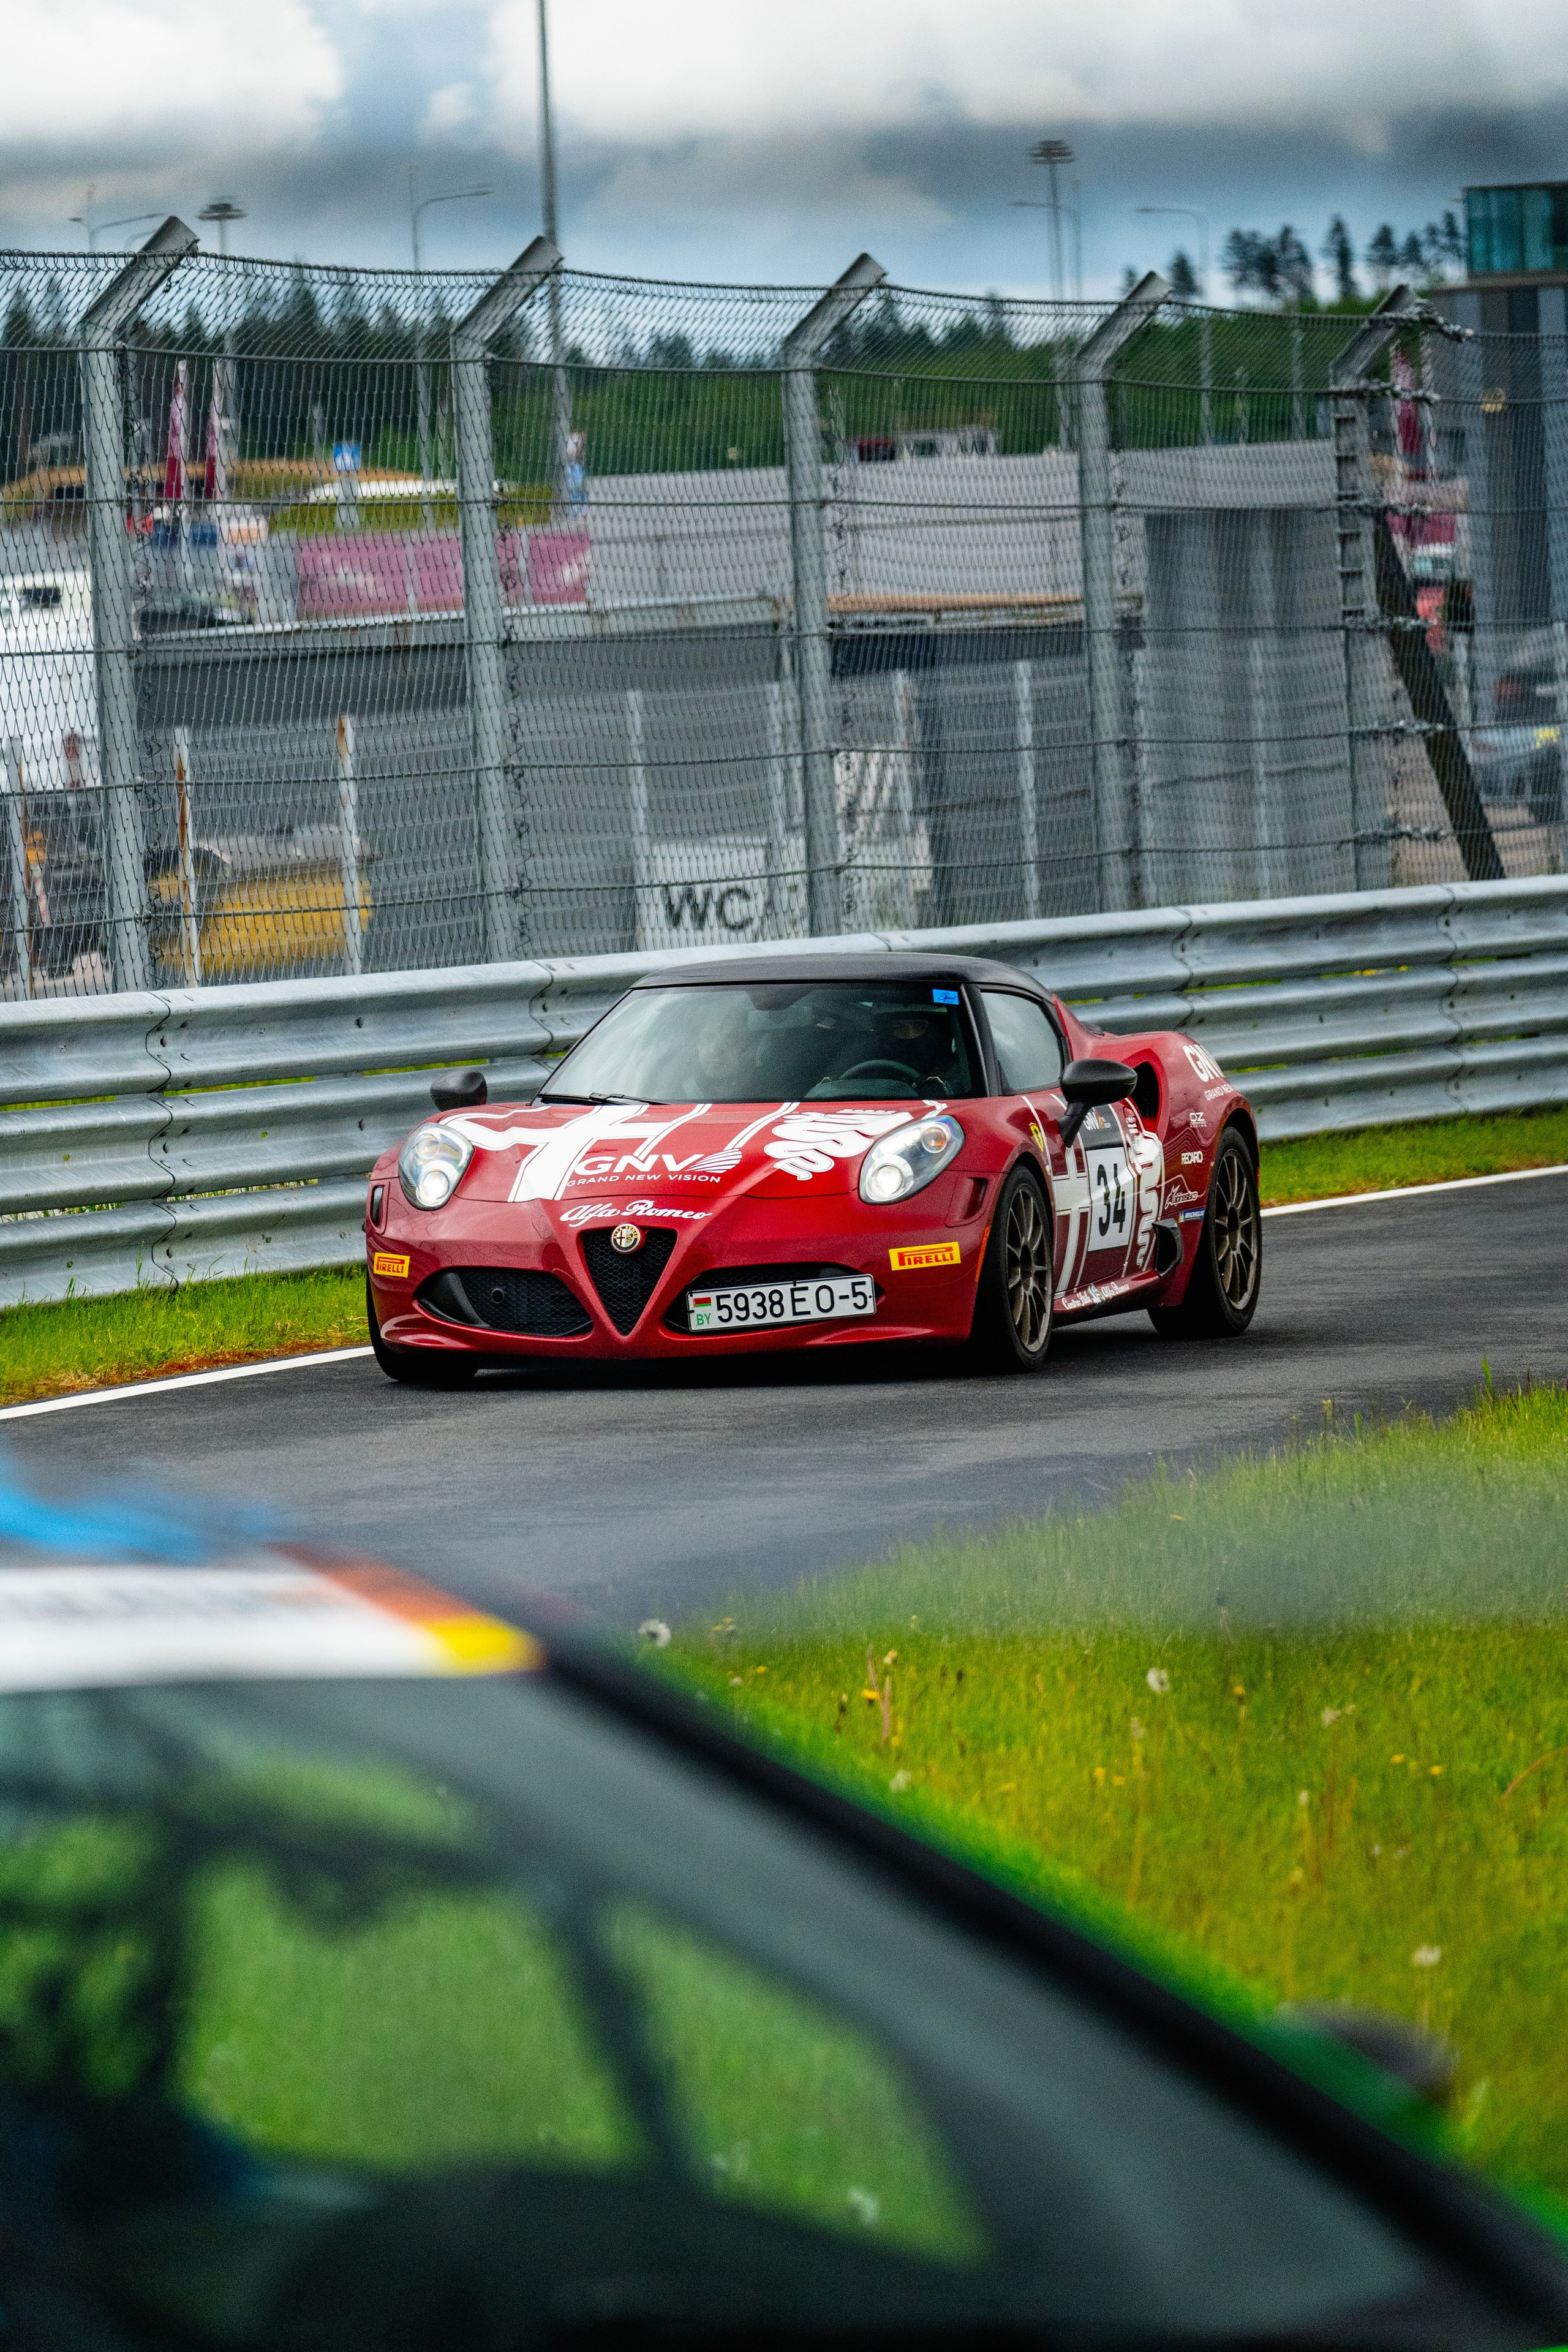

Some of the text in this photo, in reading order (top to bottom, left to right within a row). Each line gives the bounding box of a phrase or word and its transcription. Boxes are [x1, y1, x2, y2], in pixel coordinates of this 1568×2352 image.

[664, 886, 754, 930] WC
[1189, 1112, 1205, 1122] OZ
[574, 1154, 704, 1175] GNV
[1182, 1150, 1203, 1165] RECARO
[567, 1175, 620, 1187] GRAND
[668, 1174, 721, 1183] VISION
[1097, 1163, 1126, 1237] 34
[560, 1199, 713, 1227] Alfa Romeo
[376, 1256, 405, 1273] PIRELLI
[897, 1246, 954, 1267] PIRELLI
[696, 1313, 711, 1325] BY
